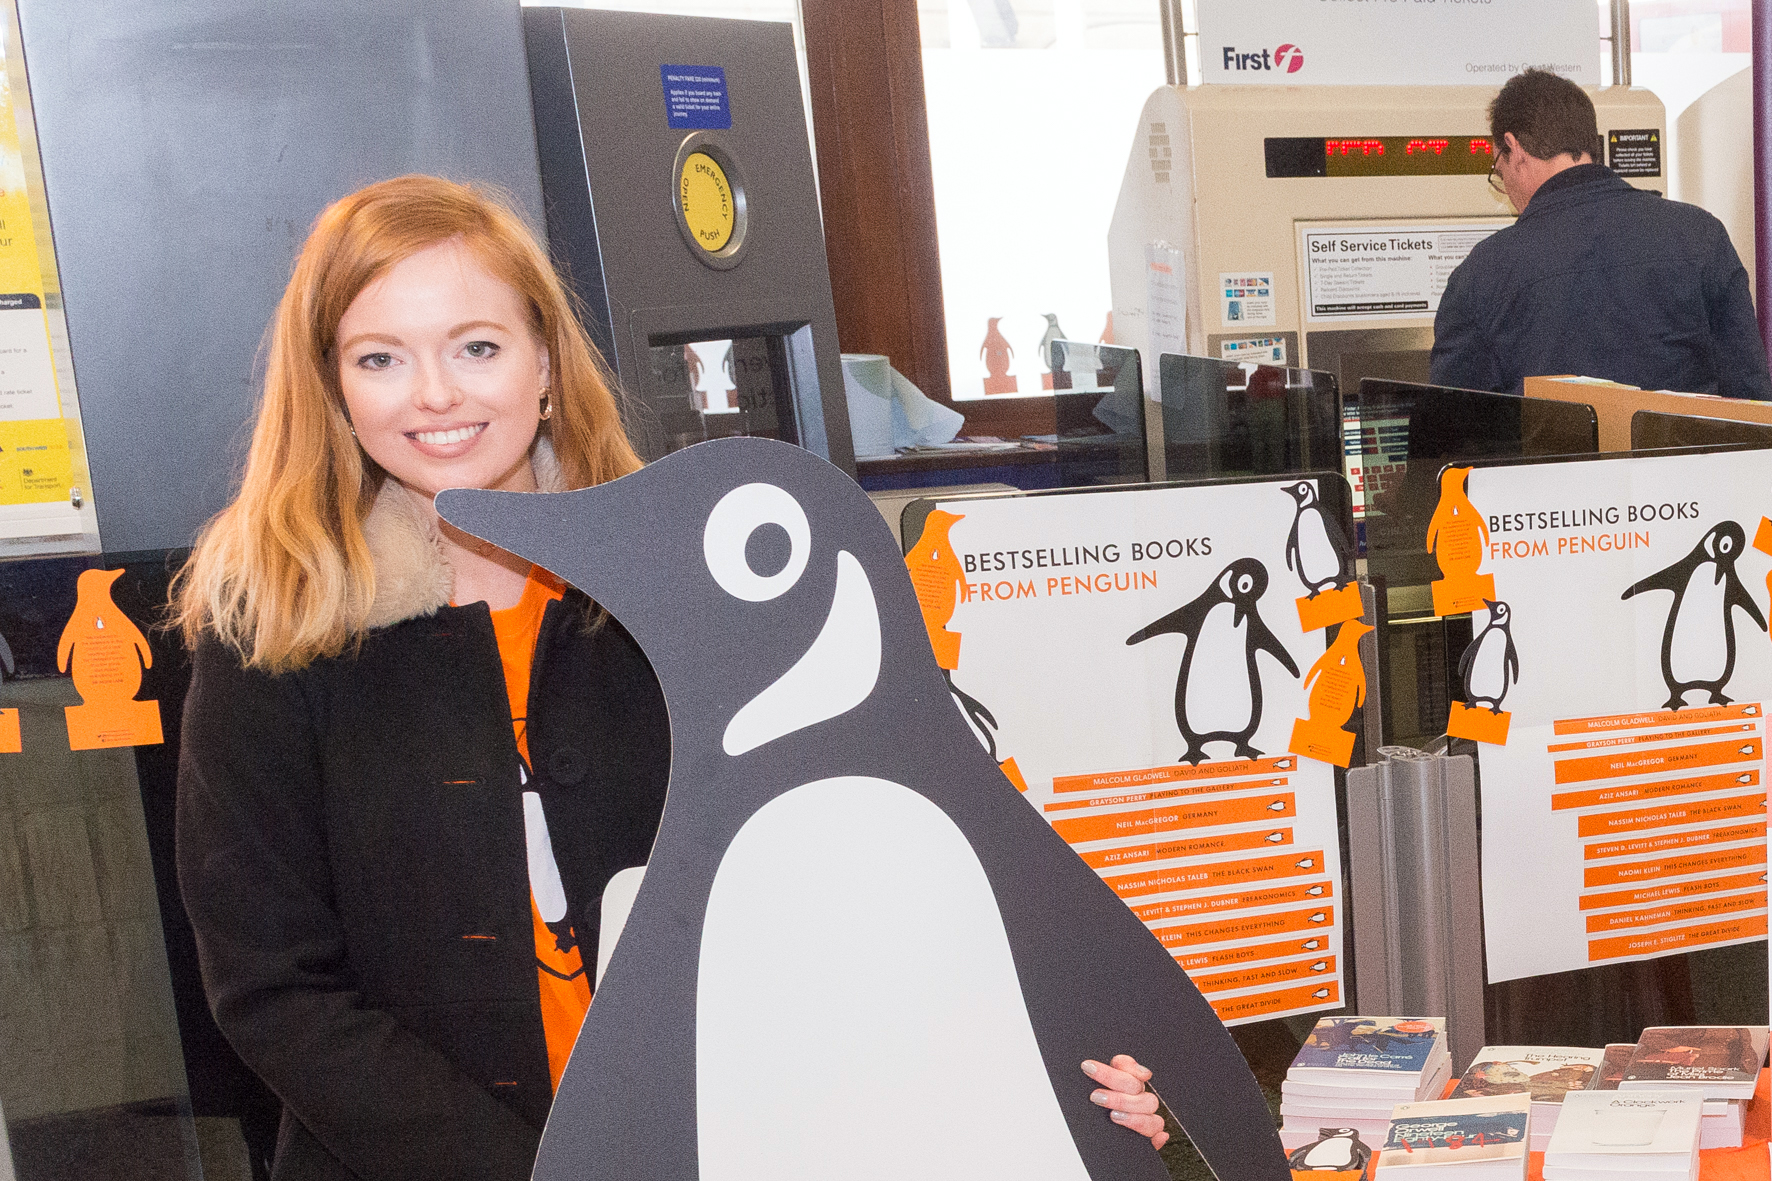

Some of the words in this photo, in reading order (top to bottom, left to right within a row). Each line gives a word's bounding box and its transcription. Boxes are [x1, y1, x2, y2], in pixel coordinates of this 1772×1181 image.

[1222, 47, 1271, 70] First
[1465, 62, 1506, 74] Operated
[1508, 62, 1519, 74] by
[695, 164, 728, 220] EMERGENCY
[700, 229, 720, 240] PUSH
[1312, 240, 1336, 252] Self
[1340, 239, 1387, 252] Service
[1389, 239, 1433, 250] Tickets
[1489, 506, 1620, 534] BESTSELLING
[1628, 501, 1699, 522] BOOKS
[964, 544, 1120, 573] BESTSELLING
[1131, 537, 1212, 561] BOOKS
[1488, 539, 1549, 560] FROM
[1558, 531, 1649, 555] PENGUIN
[965, 580, 1037, 603] FROM
[1047, 570, 1157, 596] PENGUIN
[1093, 775, 1131, 785] MALCOLM
[1132, 772, 1170, 782] GLADWELL
[1173, 768, 1197, 777] DAVID
[1217, 764, 1248, 773] GOLIATH
[1135, 815, 1178, 826] MacGREGOR
[1182, 811, 1217, 820] GERMANY
